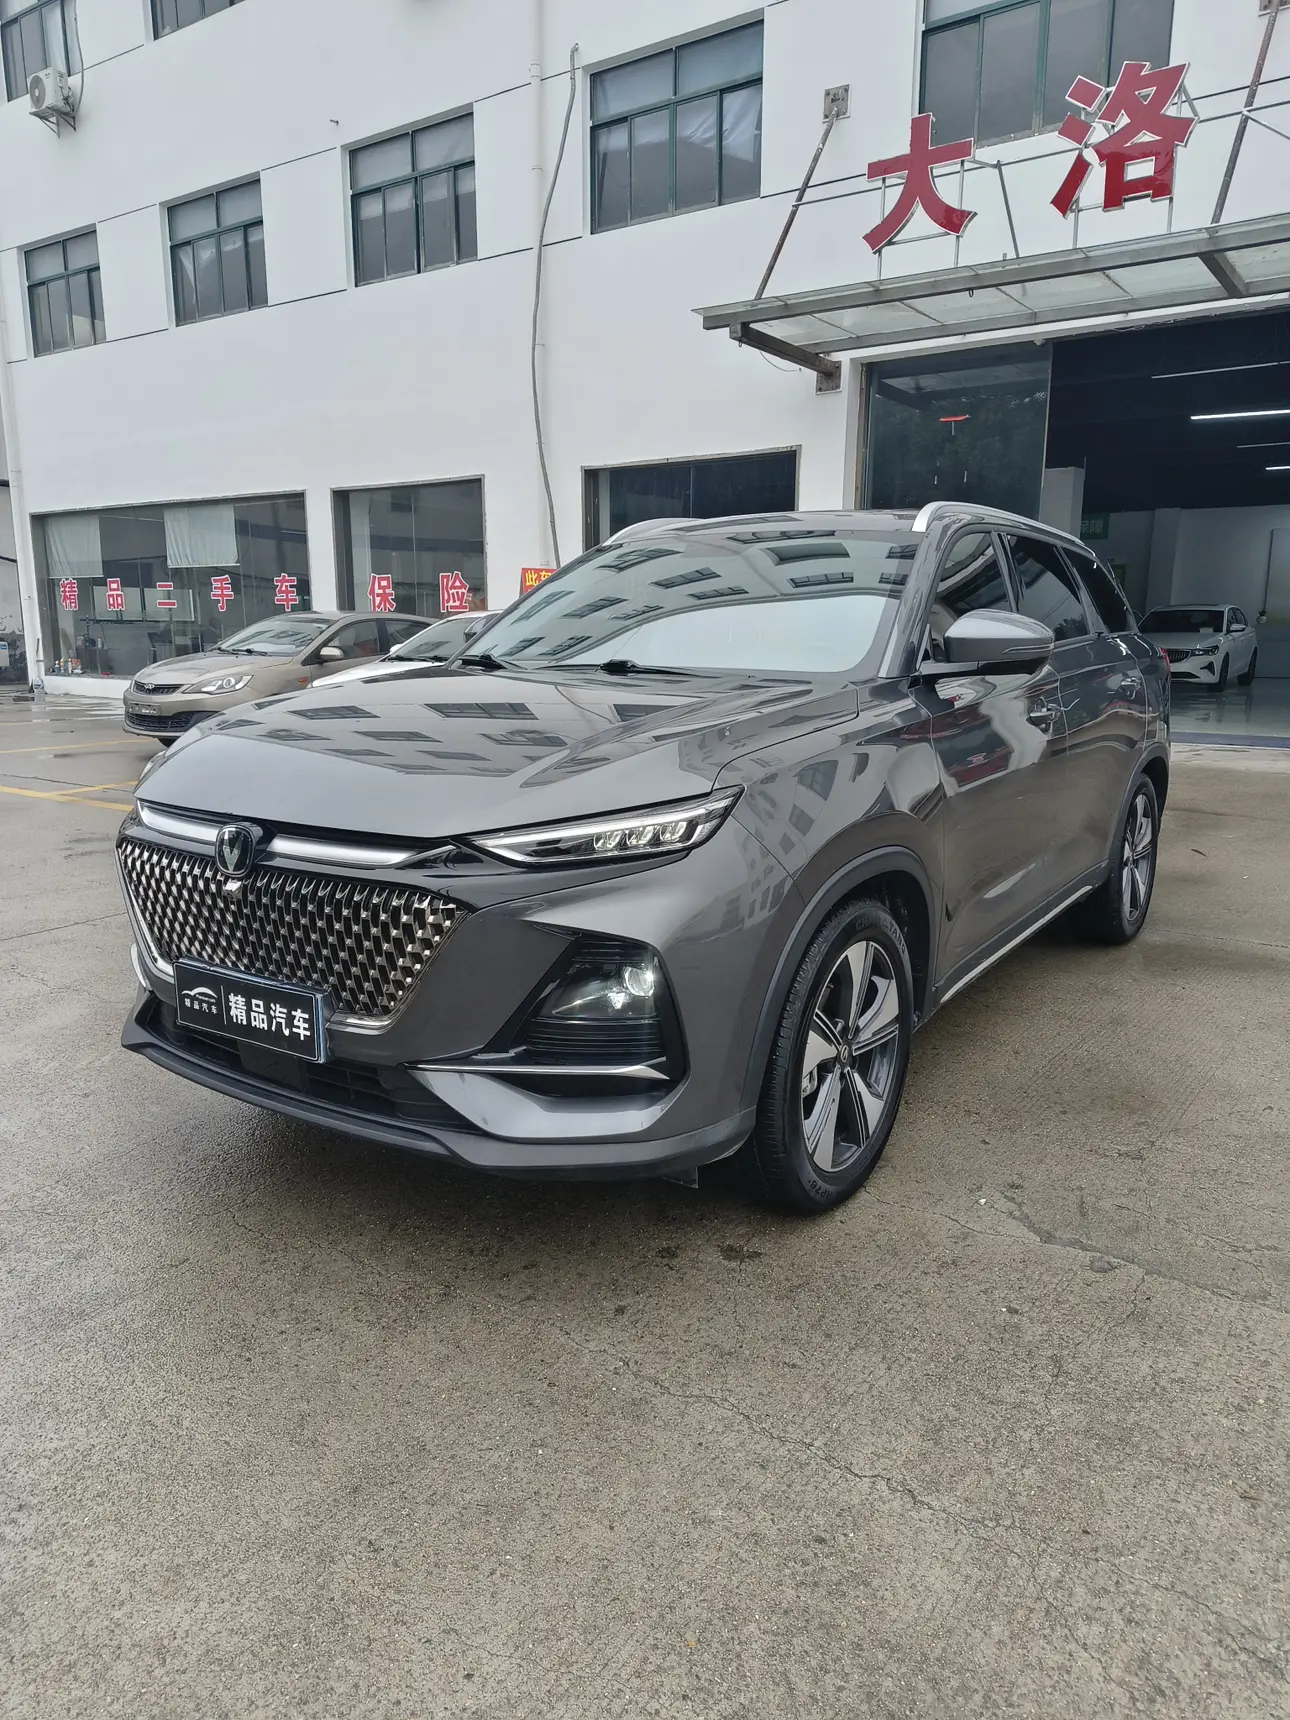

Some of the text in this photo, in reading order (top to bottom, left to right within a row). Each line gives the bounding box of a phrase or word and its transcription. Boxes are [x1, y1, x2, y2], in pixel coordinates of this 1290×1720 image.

[862, 61, 1199, 254] 大洛
[60, 571, 470, 613] 精品二手车 保险
[184, 997, 218, 1014] 精品汽车
[228, 992, 311, 1041] 精品汽车
